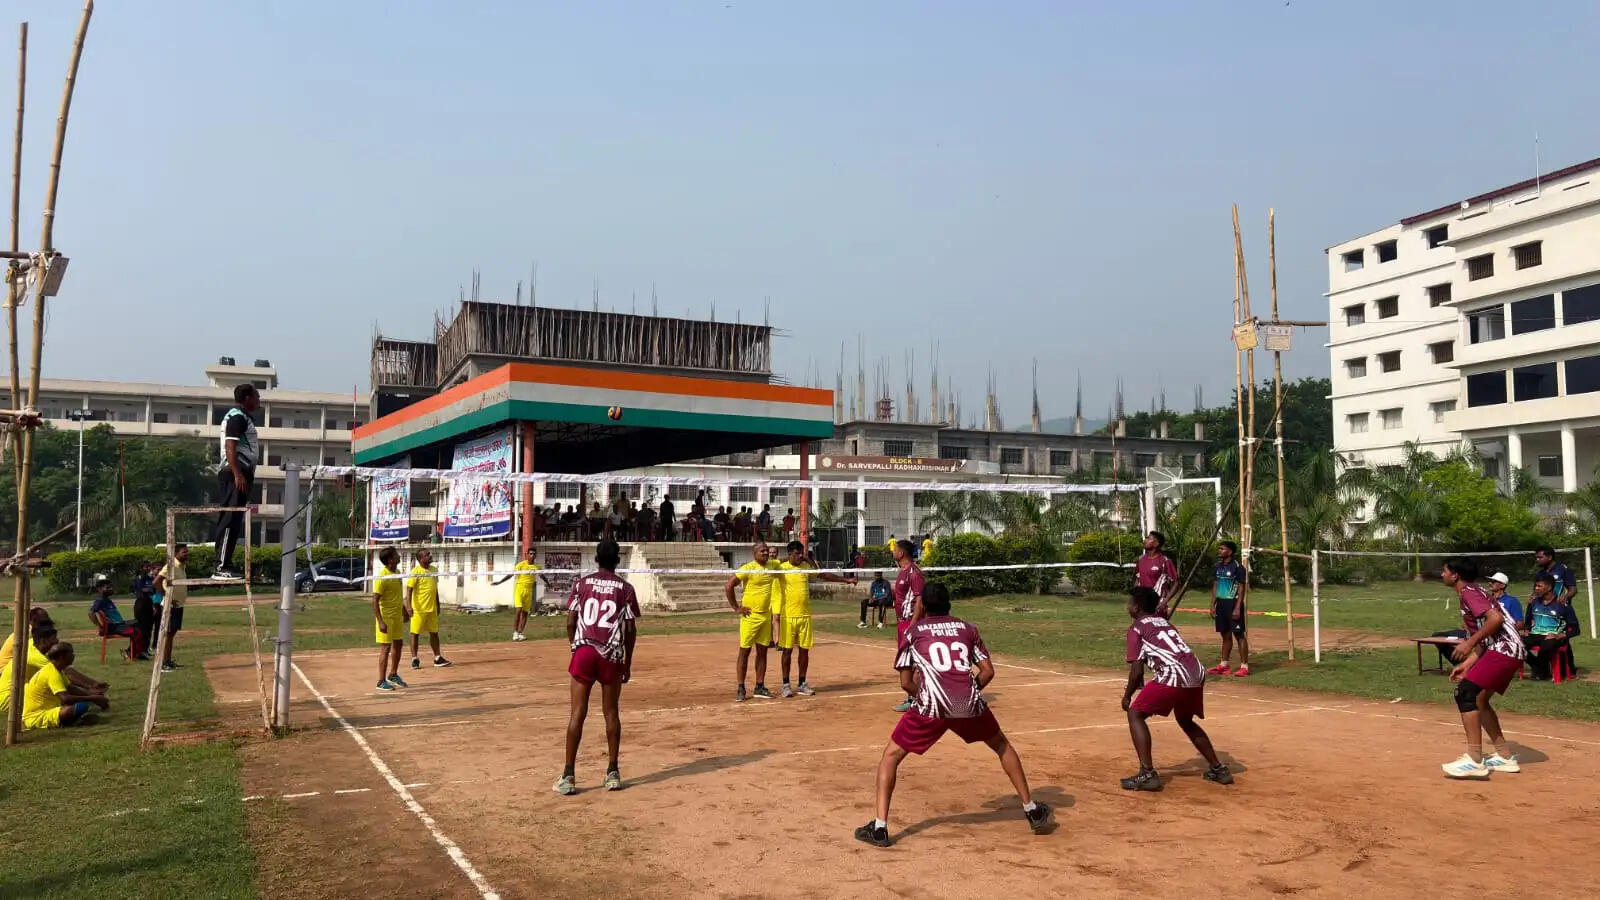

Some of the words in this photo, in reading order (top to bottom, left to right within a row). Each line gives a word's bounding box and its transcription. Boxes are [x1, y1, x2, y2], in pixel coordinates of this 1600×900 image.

[592, 585, 615, 595] POLICE
[583, 597, 617, 629] 02
[931, 628, 959, 637] POLICE
[1157, 629, 1191, 654] 13
[928, 641, 970, 672] 03
